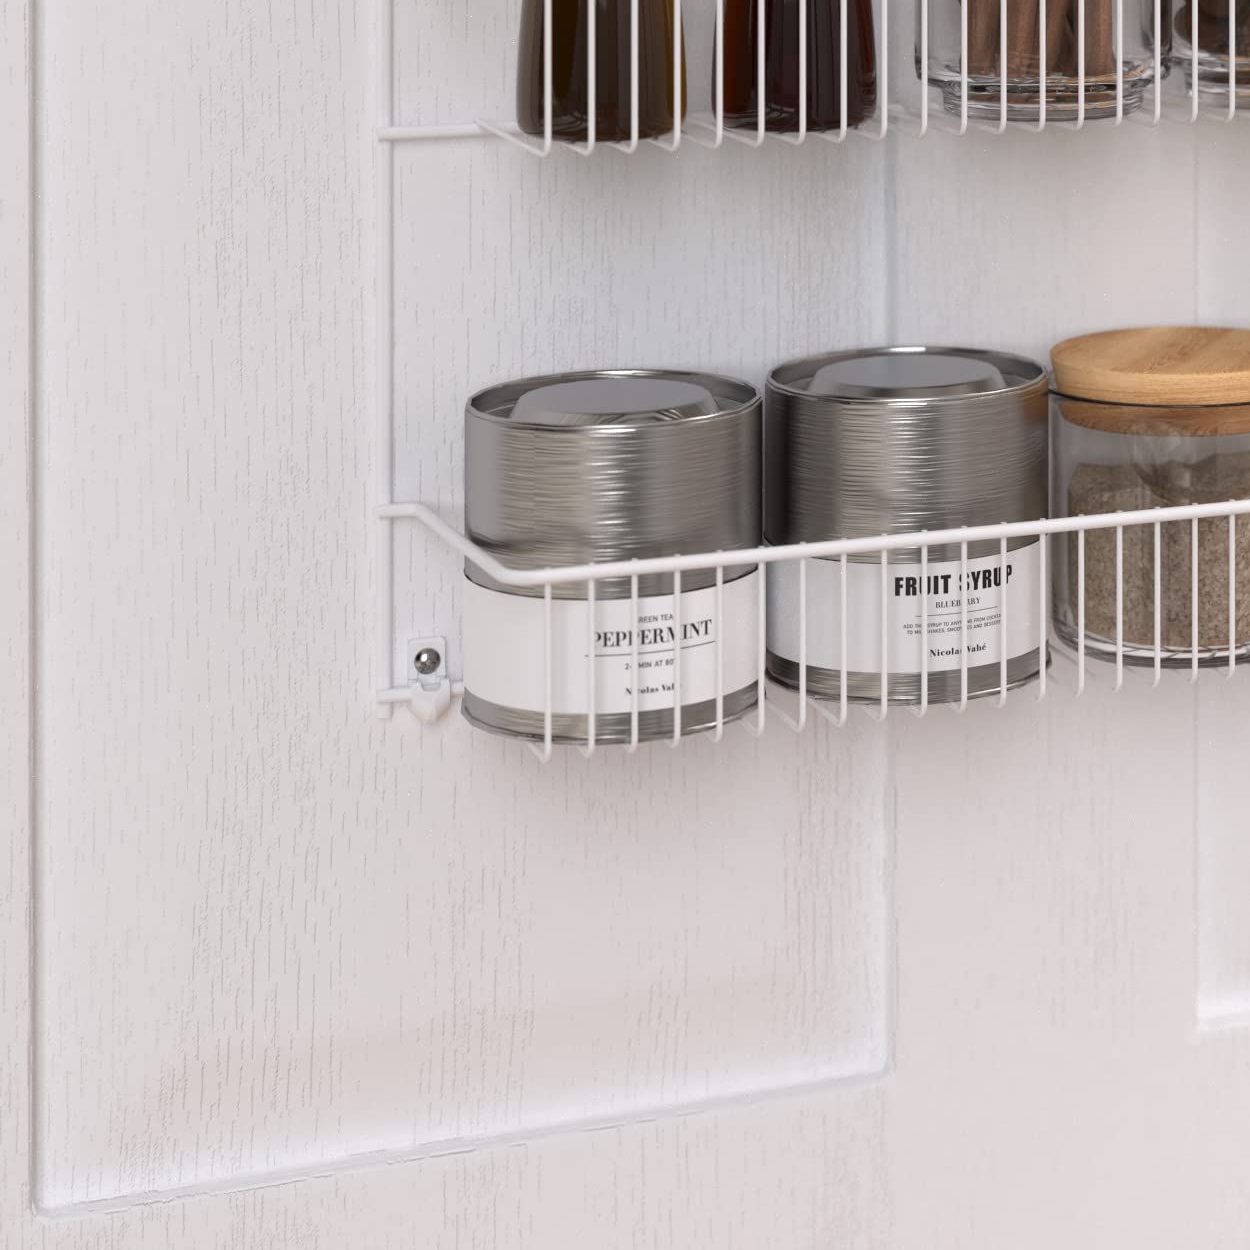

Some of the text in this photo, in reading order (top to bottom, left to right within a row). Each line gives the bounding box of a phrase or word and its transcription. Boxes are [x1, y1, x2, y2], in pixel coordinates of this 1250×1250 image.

[894, 574, 952, 597] FRUIT
[637, 614, 659, 623] REEN
[966, 642, 987, 653] Vahé
